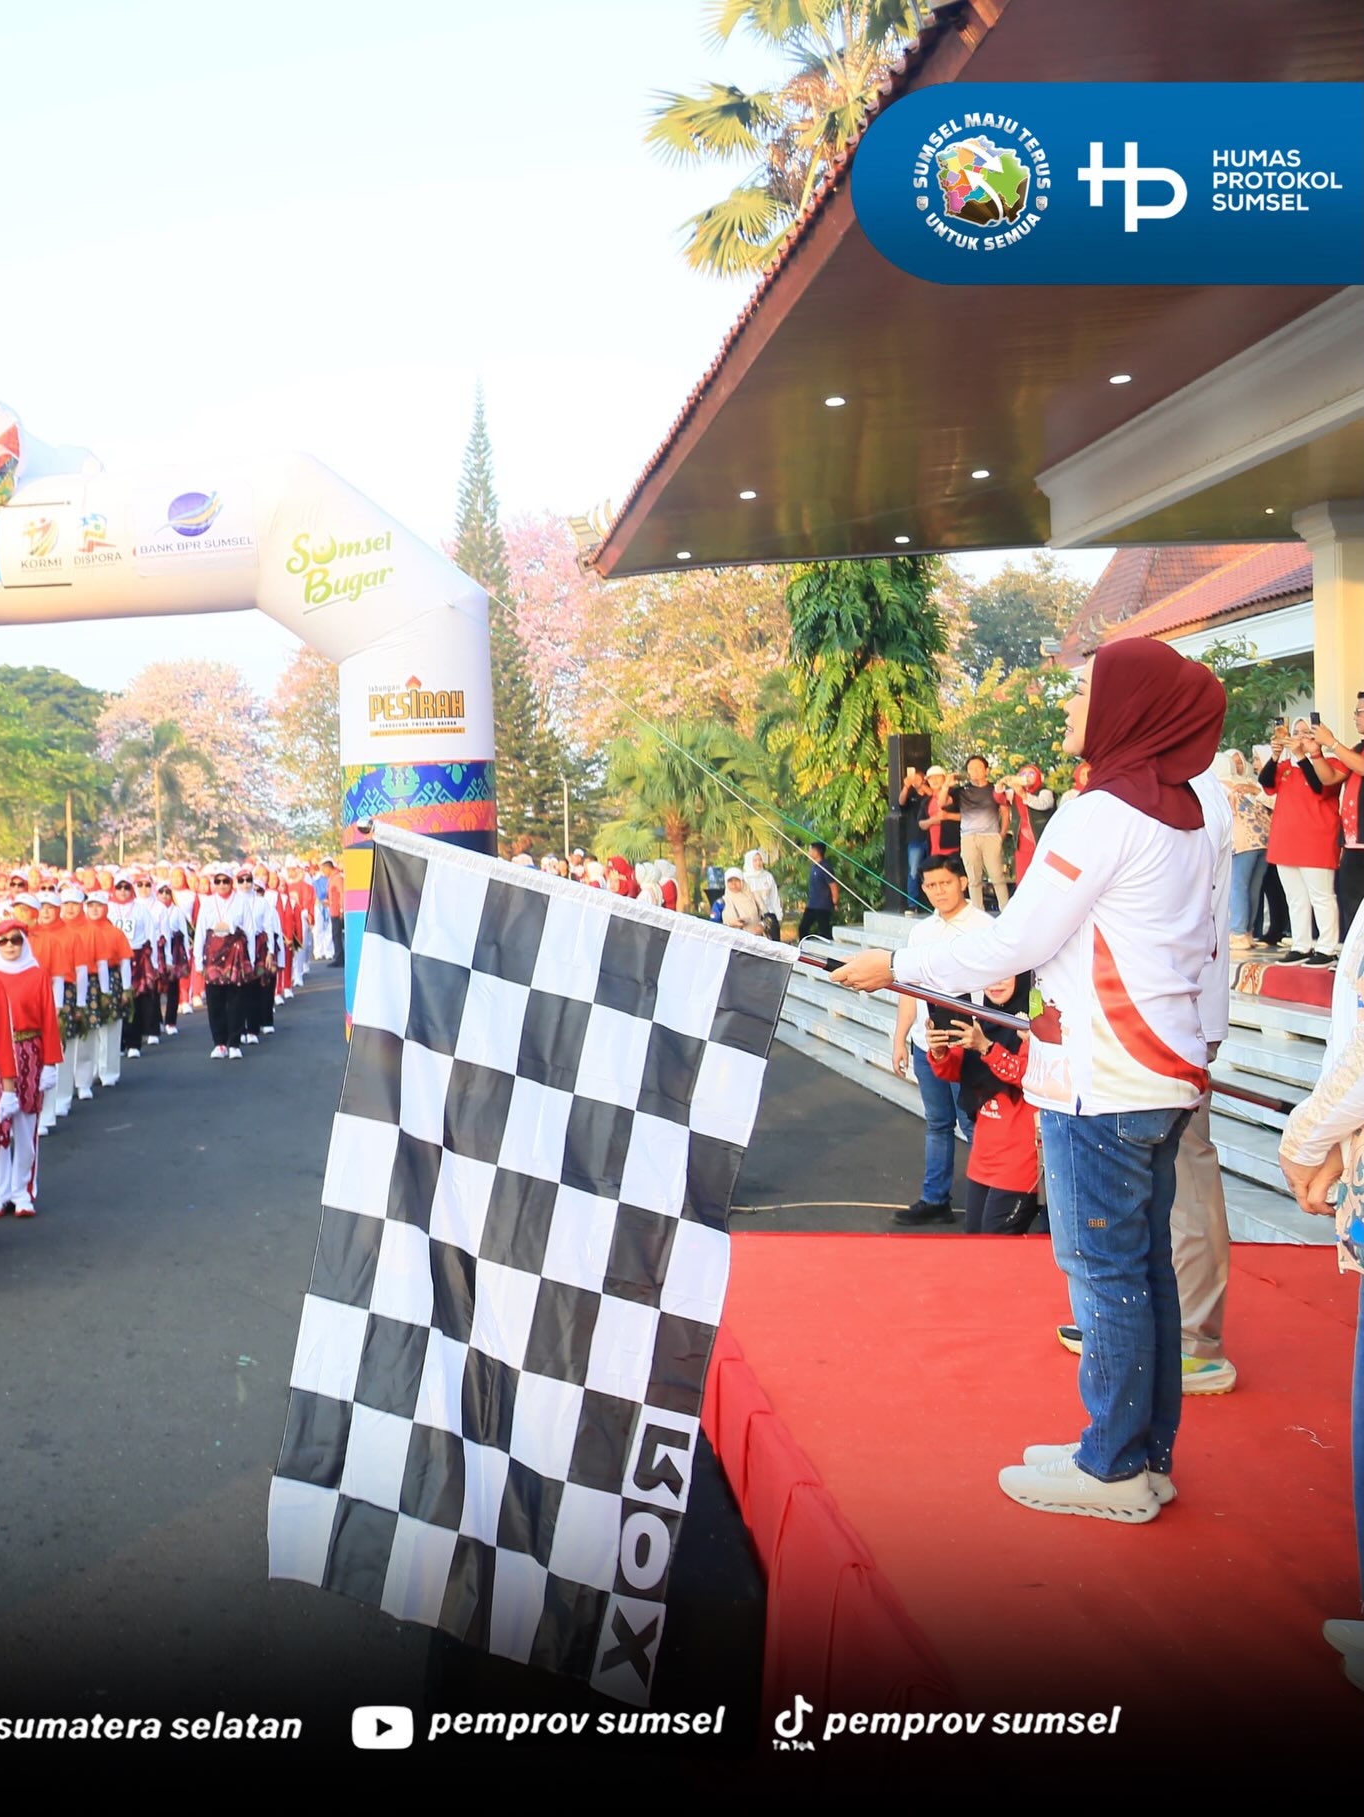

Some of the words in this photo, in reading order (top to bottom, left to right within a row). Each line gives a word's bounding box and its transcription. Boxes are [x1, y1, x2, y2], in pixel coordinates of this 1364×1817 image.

[139, 543, 174, 555] BANK
[177, 540, 202, 552] BPR
[204, 535, 254, 549] SUMSEL
[285, 530, 393, 576] Sumsel
[20, 558, 63, 570] KORMI
[73, 551, 123, 566] DISPORA
[303, 564, 395, 604] Bugar
[368, 689, 466, 722] PESIRAH
